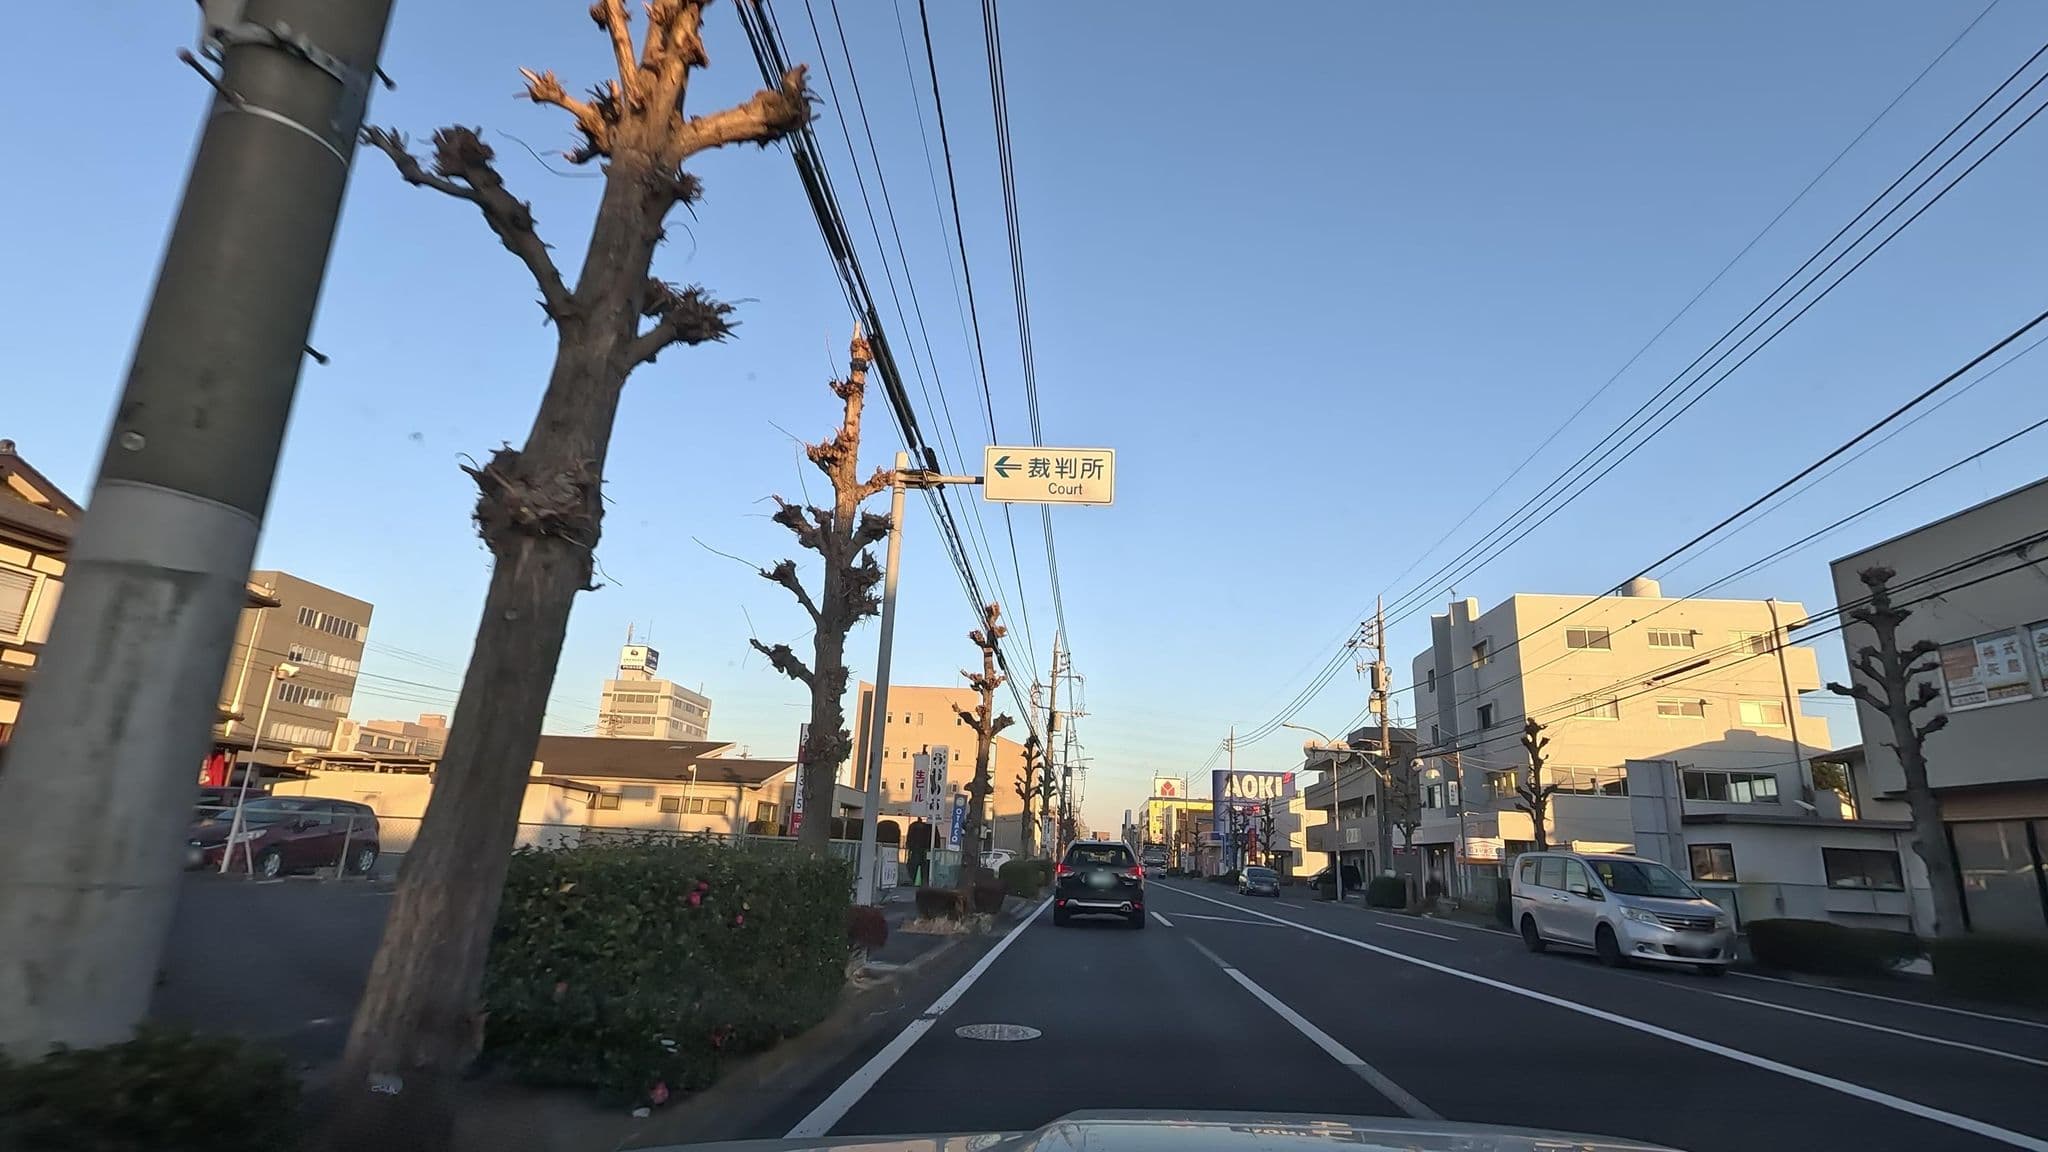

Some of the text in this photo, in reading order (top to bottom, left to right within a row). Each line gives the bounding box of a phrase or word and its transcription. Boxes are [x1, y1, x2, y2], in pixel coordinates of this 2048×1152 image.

[1028, 457, 1104, 480] 裁判所
[1048, 483, 1083, 495] Court
[915, 769, 925, 803] 生ビール
[1224, 774, 1283, 799] AOKI
[951, 807, 962, 842] OTACO
